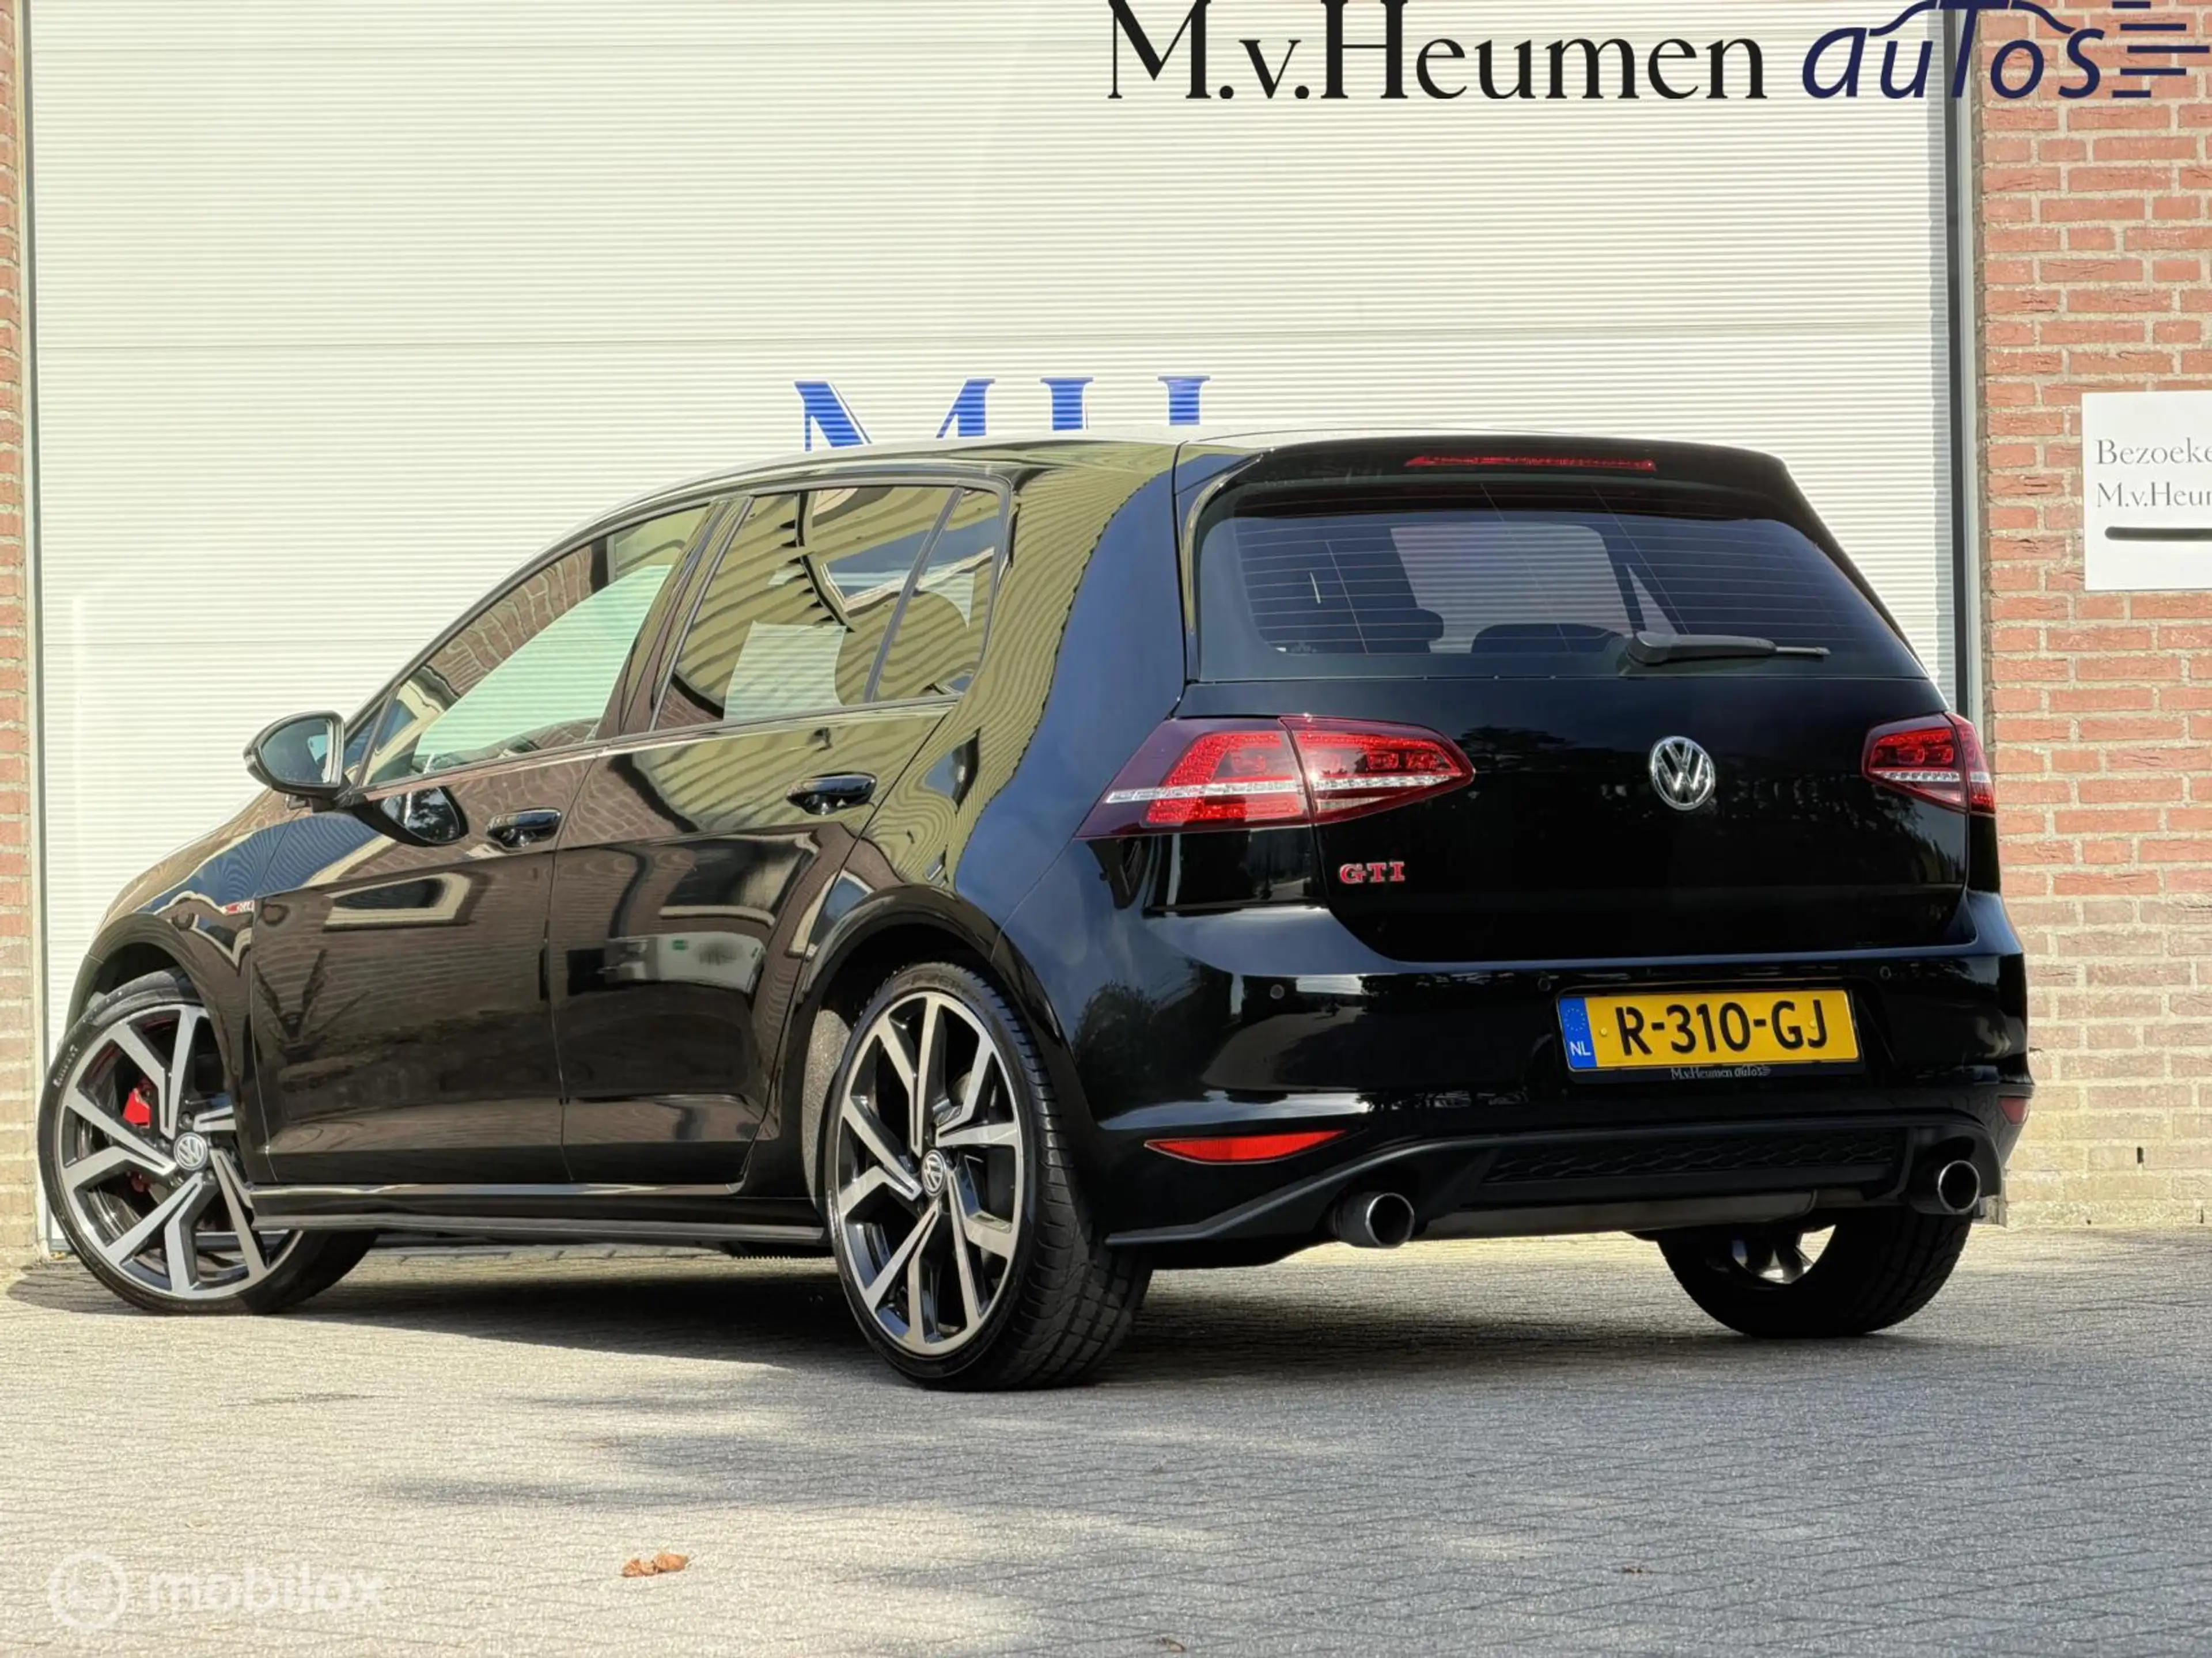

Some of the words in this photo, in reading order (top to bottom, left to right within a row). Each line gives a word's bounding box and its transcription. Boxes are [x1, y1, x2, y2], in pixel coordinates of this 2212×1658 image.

[1339, 861, 1406, 884] GTI
[1615, 999, 1828, 1056] R-310-GJ
[1570, 1041, 1591, 1057] NL
